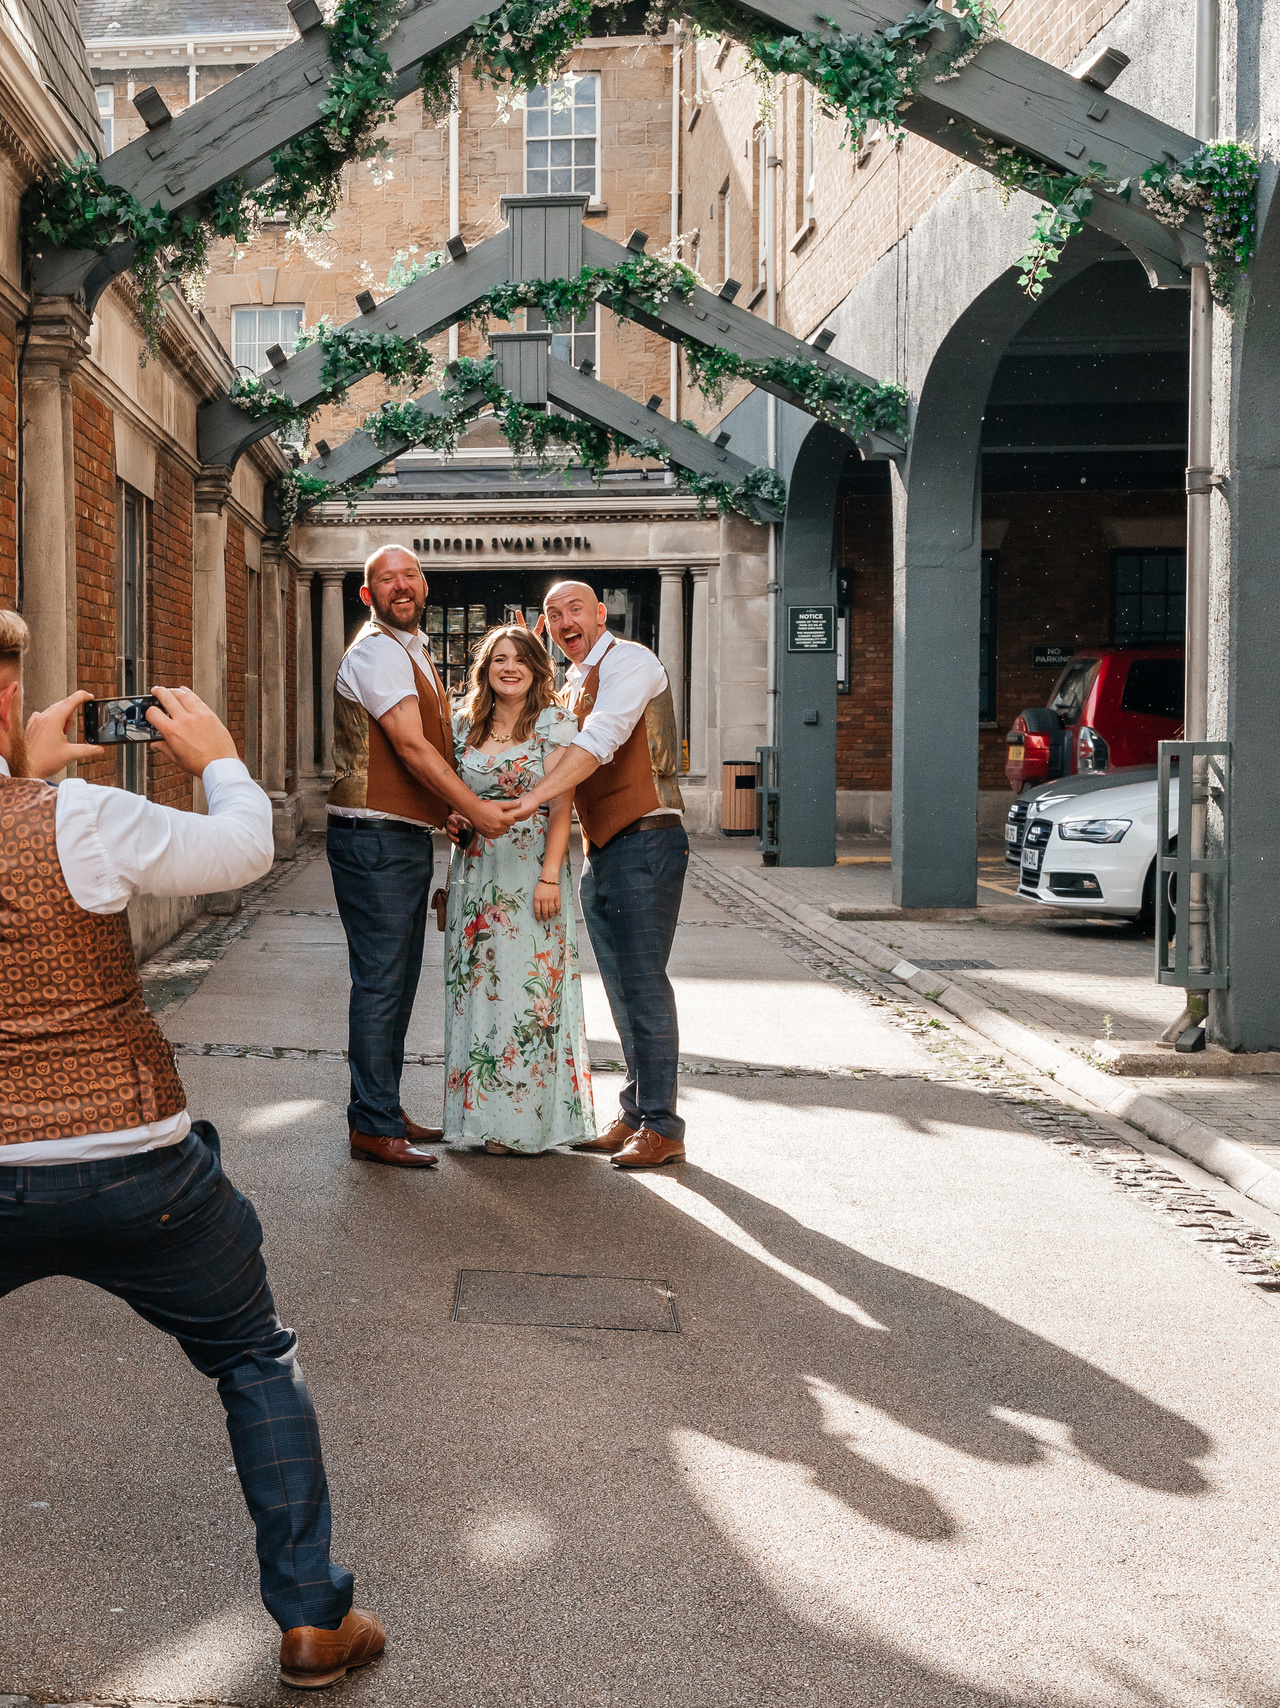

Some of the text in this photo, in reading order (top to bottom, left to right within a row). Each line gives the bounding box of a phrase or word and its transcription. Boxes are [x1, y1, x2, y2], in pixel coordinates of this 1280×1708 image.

[413, 536, 591, 551] BEDFORD SWAN HOTEL
